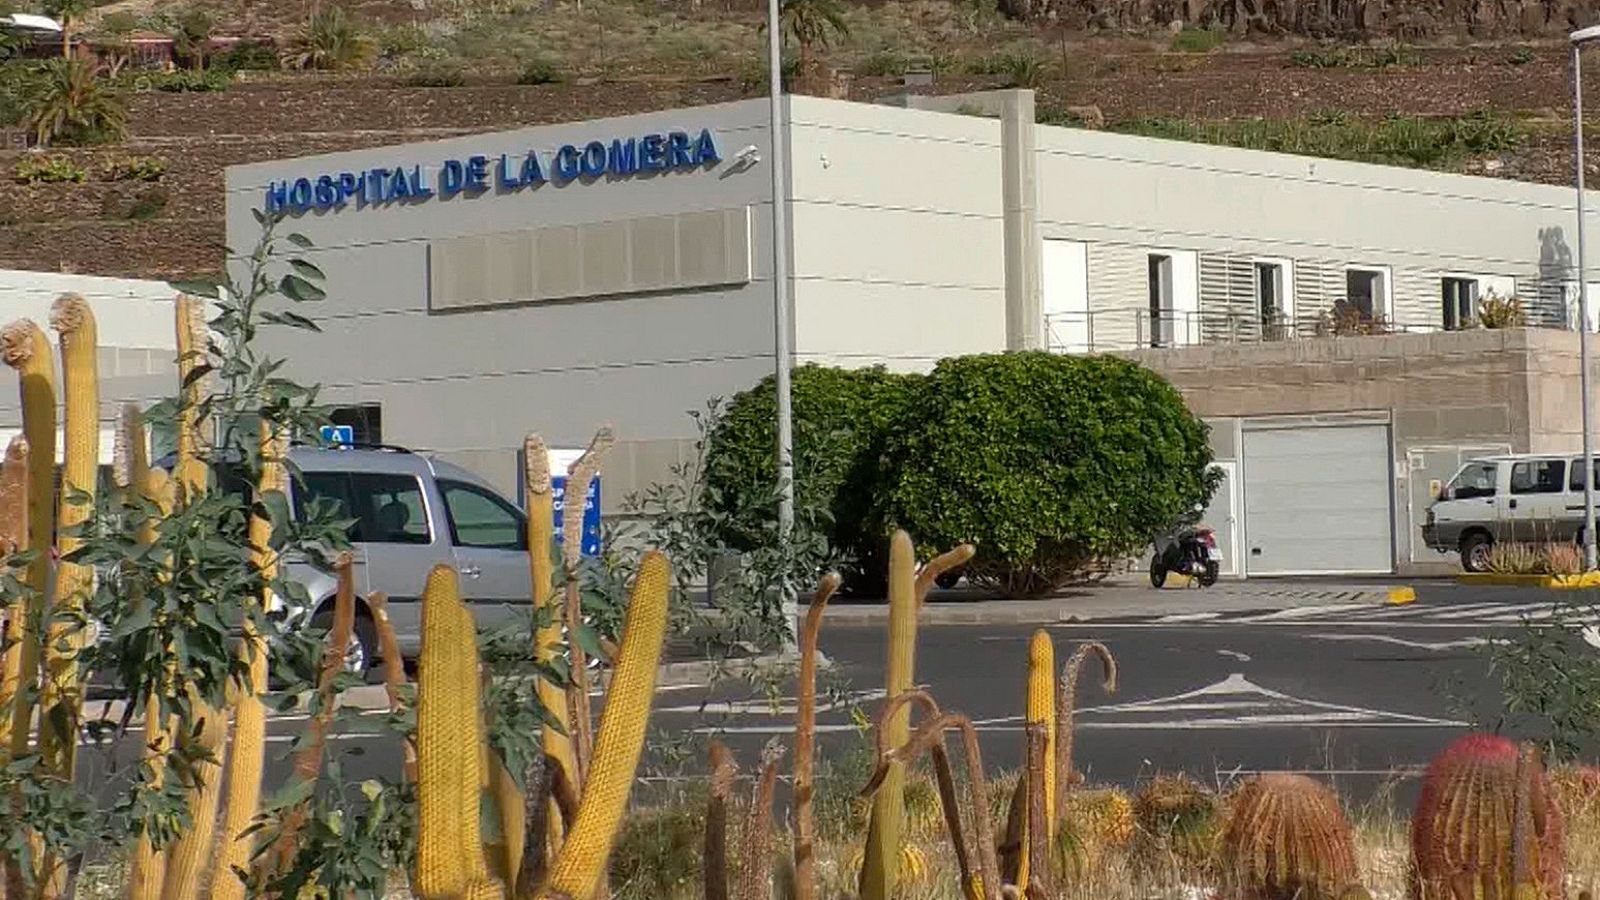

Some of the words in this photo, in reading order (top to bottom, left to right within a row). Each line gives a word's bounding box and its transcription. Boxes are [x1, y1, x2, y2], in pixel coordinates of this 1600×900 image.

[265, 163, 432, 213] HOSPITAL
[446, 155, 488, 194] DE
[499, 149, 549, 188] LA
[556, 127, 721, 182] GOMERA
[332, 430, 343, 442] A
